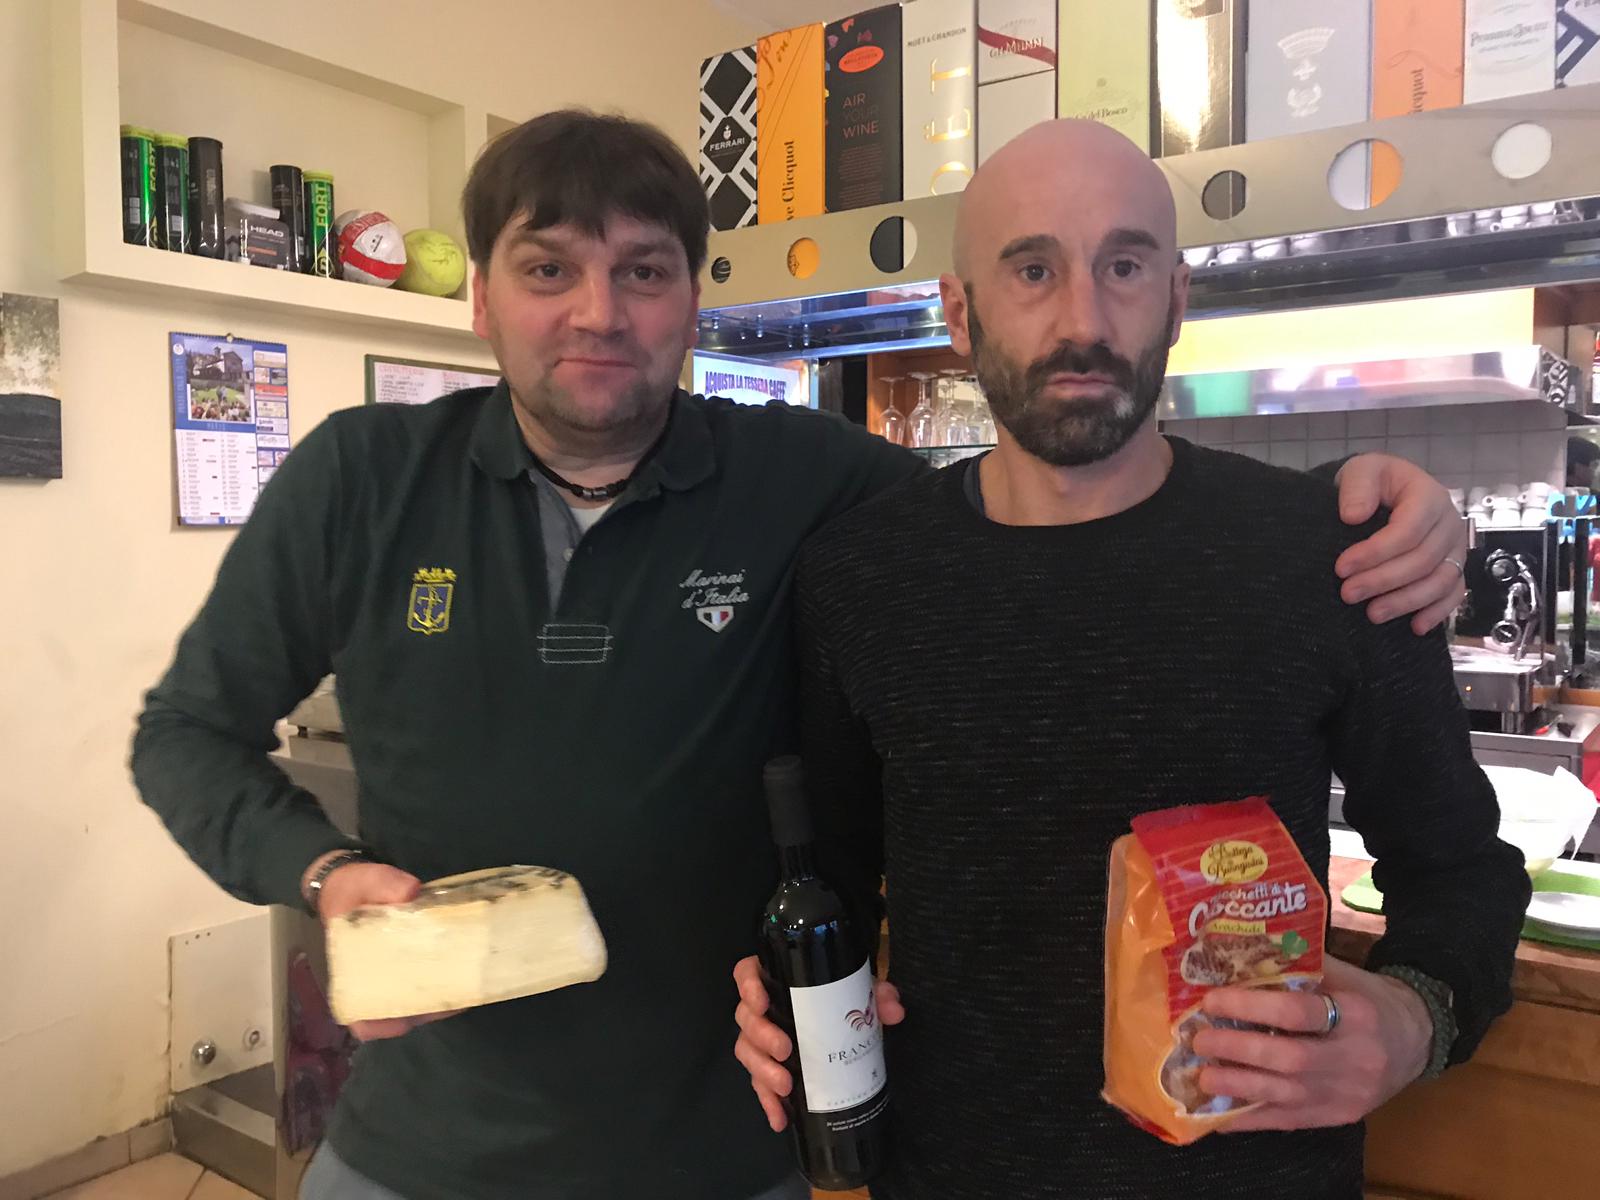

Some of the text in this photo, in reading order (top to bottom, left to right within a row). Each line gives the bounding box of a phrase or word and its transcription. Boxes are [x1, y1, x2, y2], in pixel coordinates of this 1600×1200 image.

[842, 92, 866, 109] AIR
[843, 104, 880, 122] YOUR
[842, 120, 880, 139] WINE
[709, 137, 746, 152] FERRARI
[781, 140, 798, 203] Clicquot
[316, 183, 329, 228] FORT
[250, 225, 285, 238] HEAD
[705, 371, 735, 395] ACQUISTA
[736, 374, 744, 388] LA
[744, 376, 768, 394] TESSERA
[679, 569, 746, 588] Marinai
[681, 586, 750, 609] d'Italia
[1271, 882, 1282, 896] di
